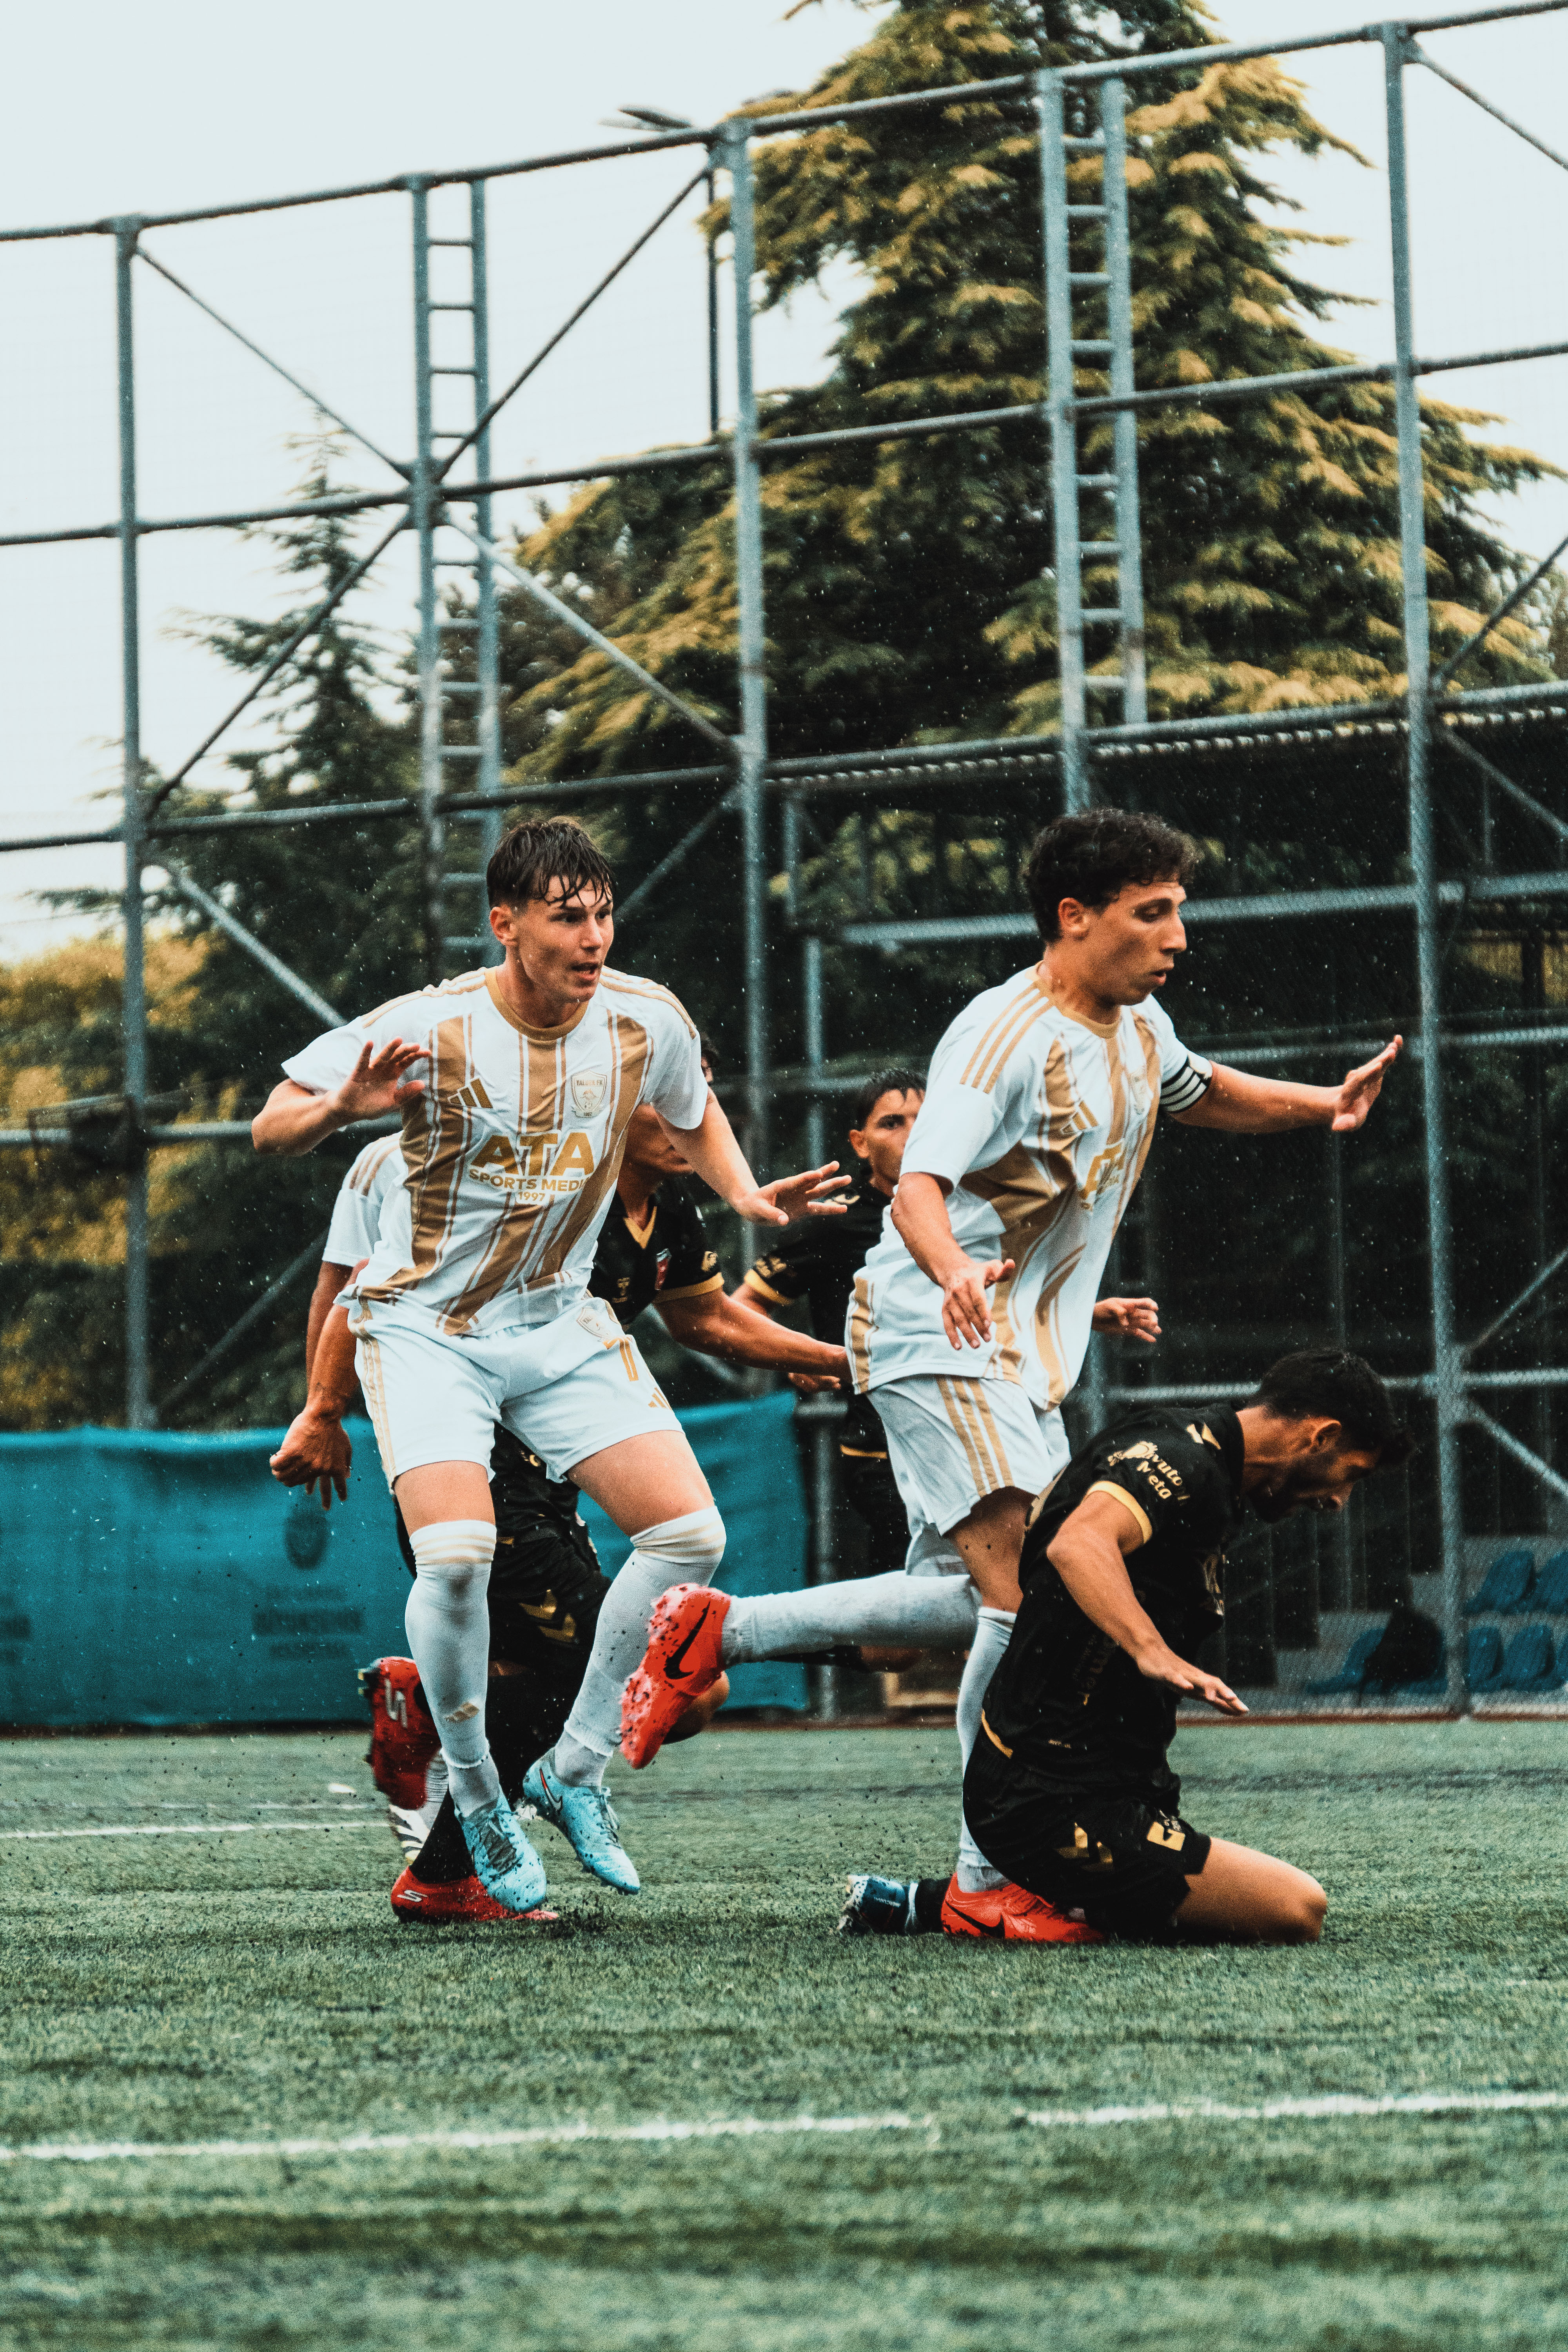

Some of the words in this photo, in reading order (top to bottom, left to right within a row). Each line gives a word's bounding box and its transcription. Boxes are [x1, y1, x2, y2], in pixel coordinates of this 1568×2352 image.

[470, 1132, 594, 1176] ATA
[469, 1168, 537, 1190] SPORTS
[541, 1179, 587, 1192] MEDI
[518, 1191, 545, 1201] 1997
